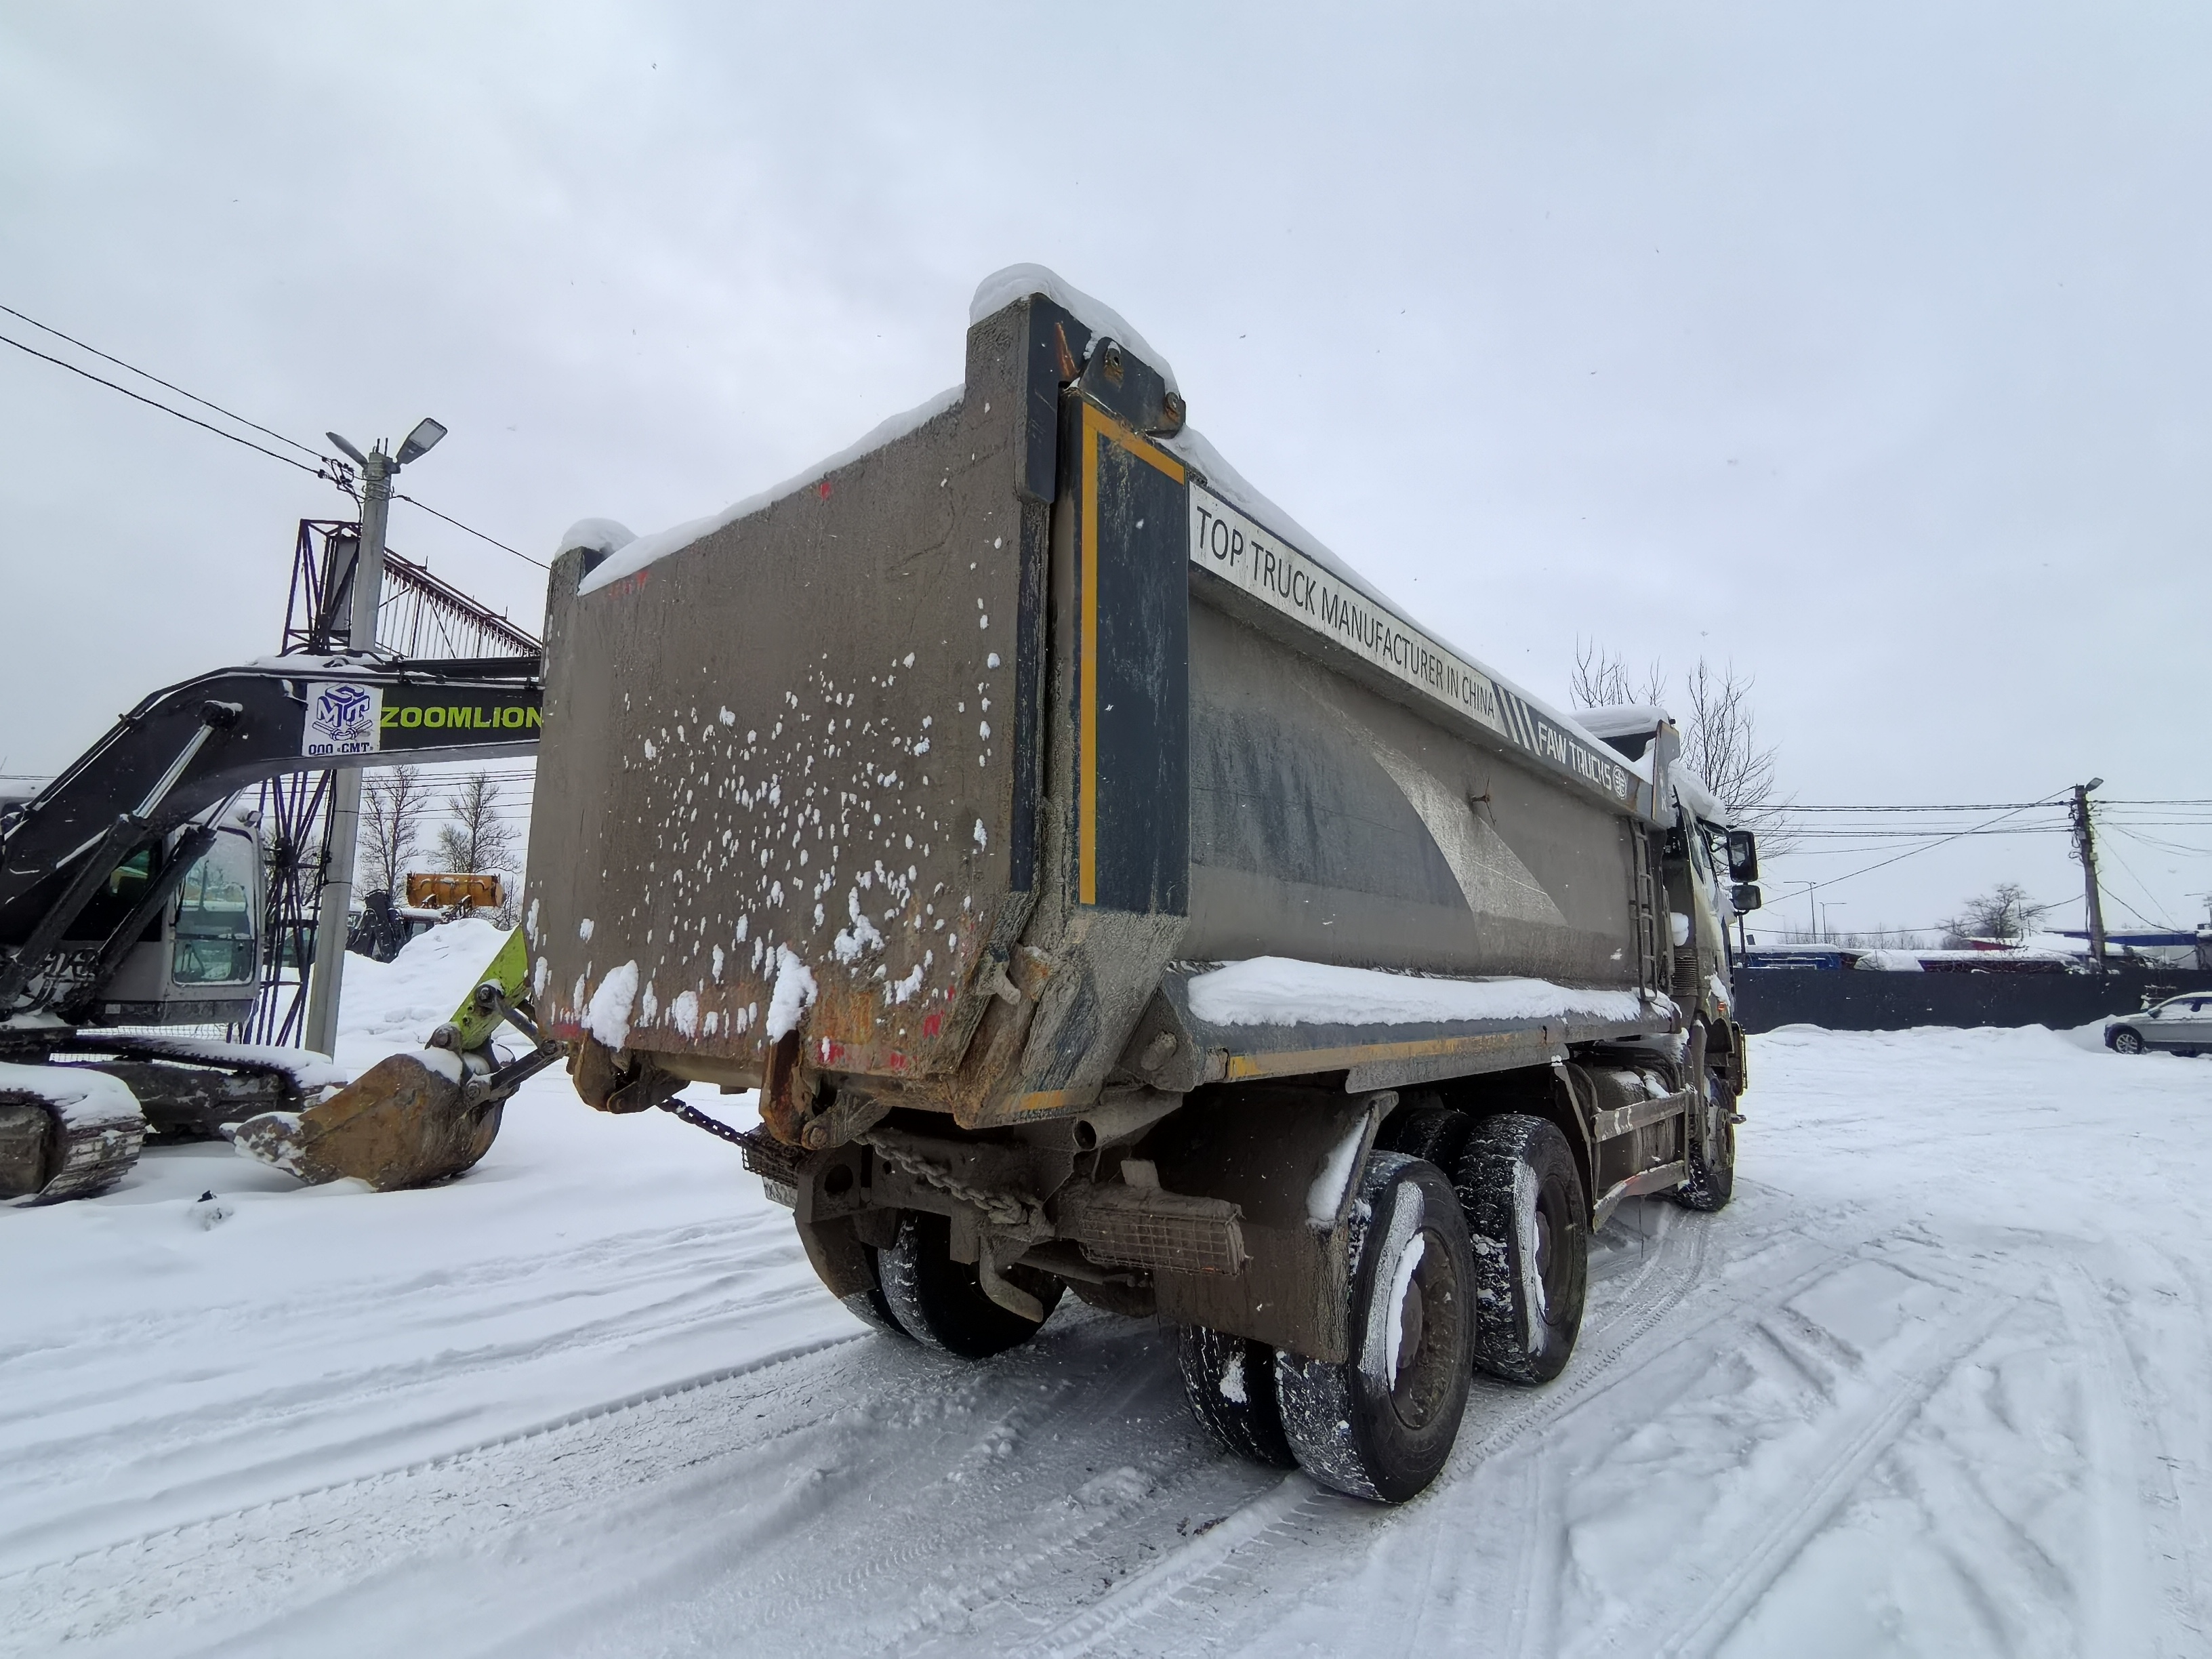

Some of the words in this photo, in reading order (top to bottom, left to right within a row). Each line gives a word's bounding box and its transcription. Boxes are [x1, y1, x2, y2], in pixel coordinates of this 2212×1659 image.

[1197, 506, 1244, 567] TOP
[1251, 540, 1316, 615] TRUCK
[1322, 587, 1443, 690] MANUFACTURER
[1447, 665, 1459, 699] IN
[1462, 676, 1495, 719] CHINA
[380, 707, 543, 728] ZOOMLION
[1538, 721, 1566, 764] FAW
[1569, 741, 1612, 791] TRUCKS
